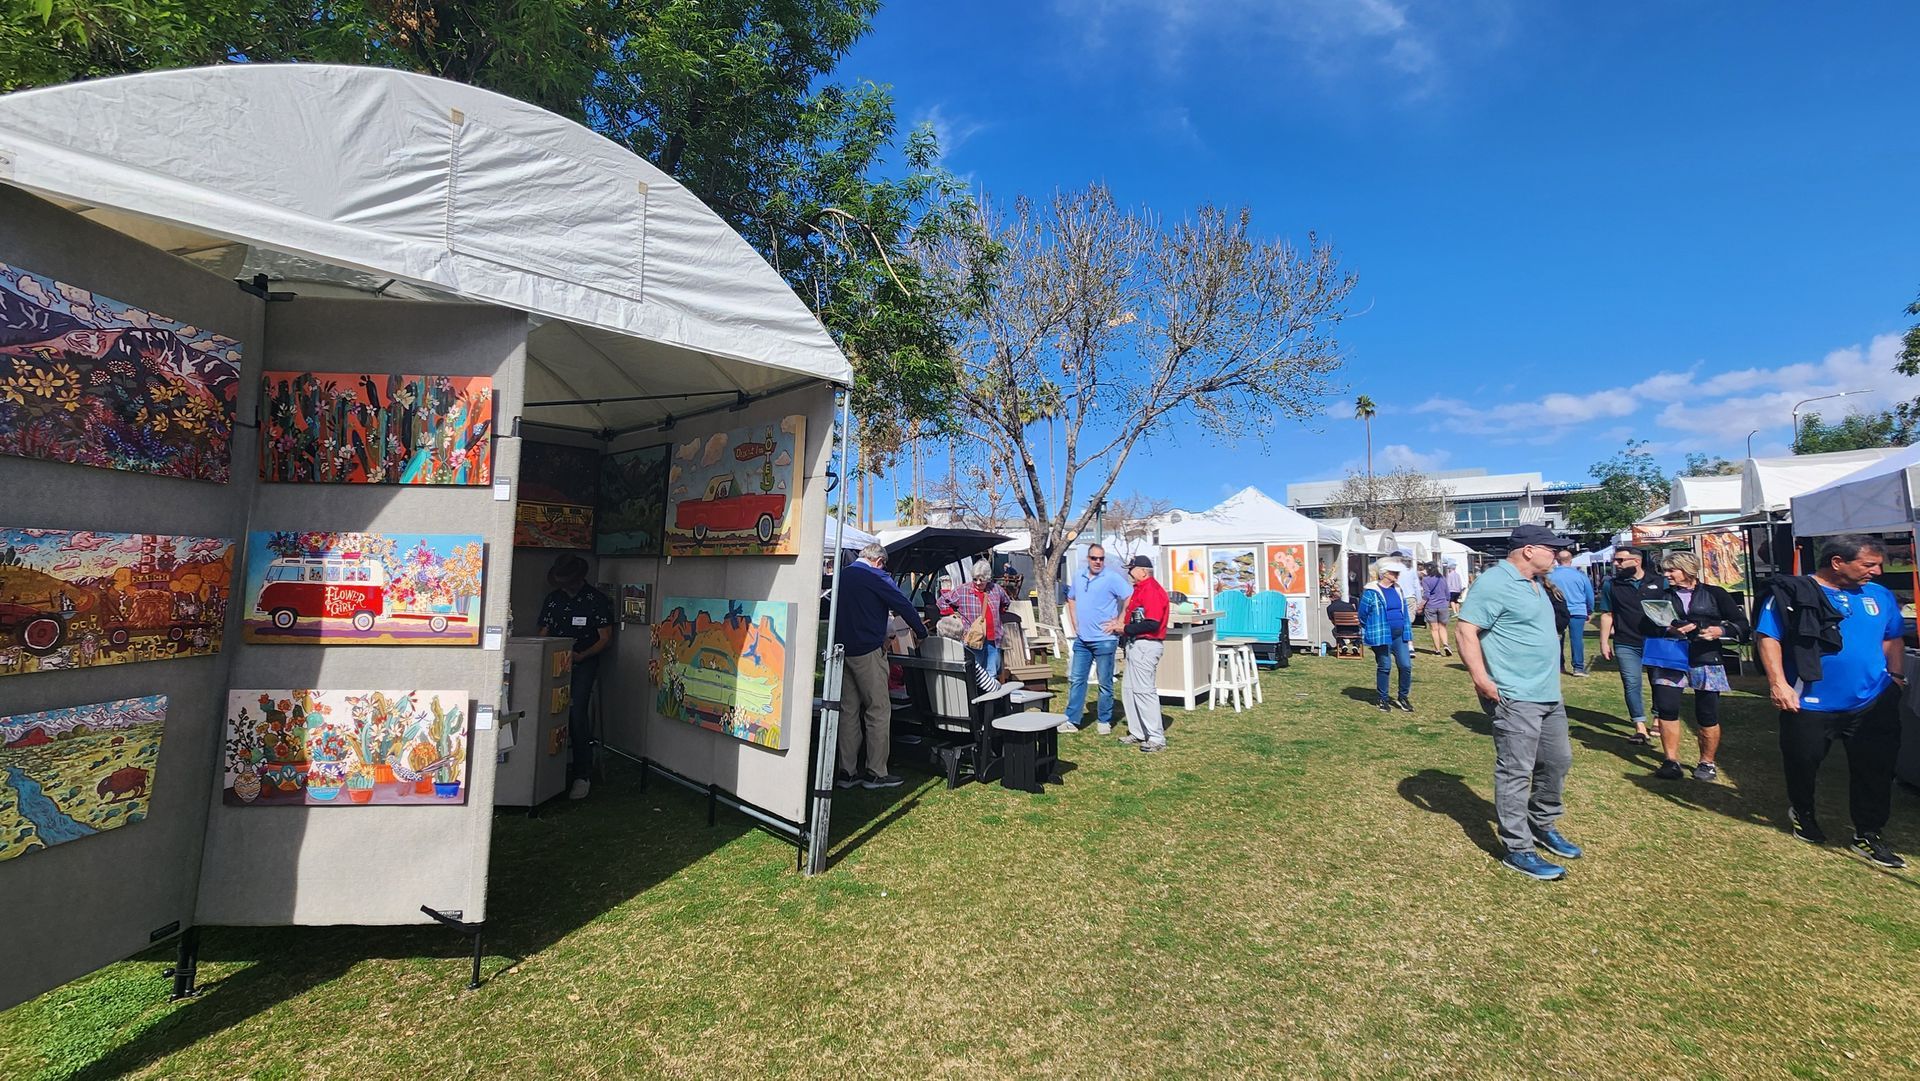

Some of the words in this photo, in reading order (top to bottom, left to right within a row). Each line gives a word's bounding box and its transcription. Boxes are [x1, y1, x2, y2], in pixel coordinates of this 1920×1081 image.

[764, 426, 773, 485] MOTEL
[141, 534, 152, 574] DUDE
[132, 574, 168, 583] RANCH
[325, 586, 366, 611] FLOWER
